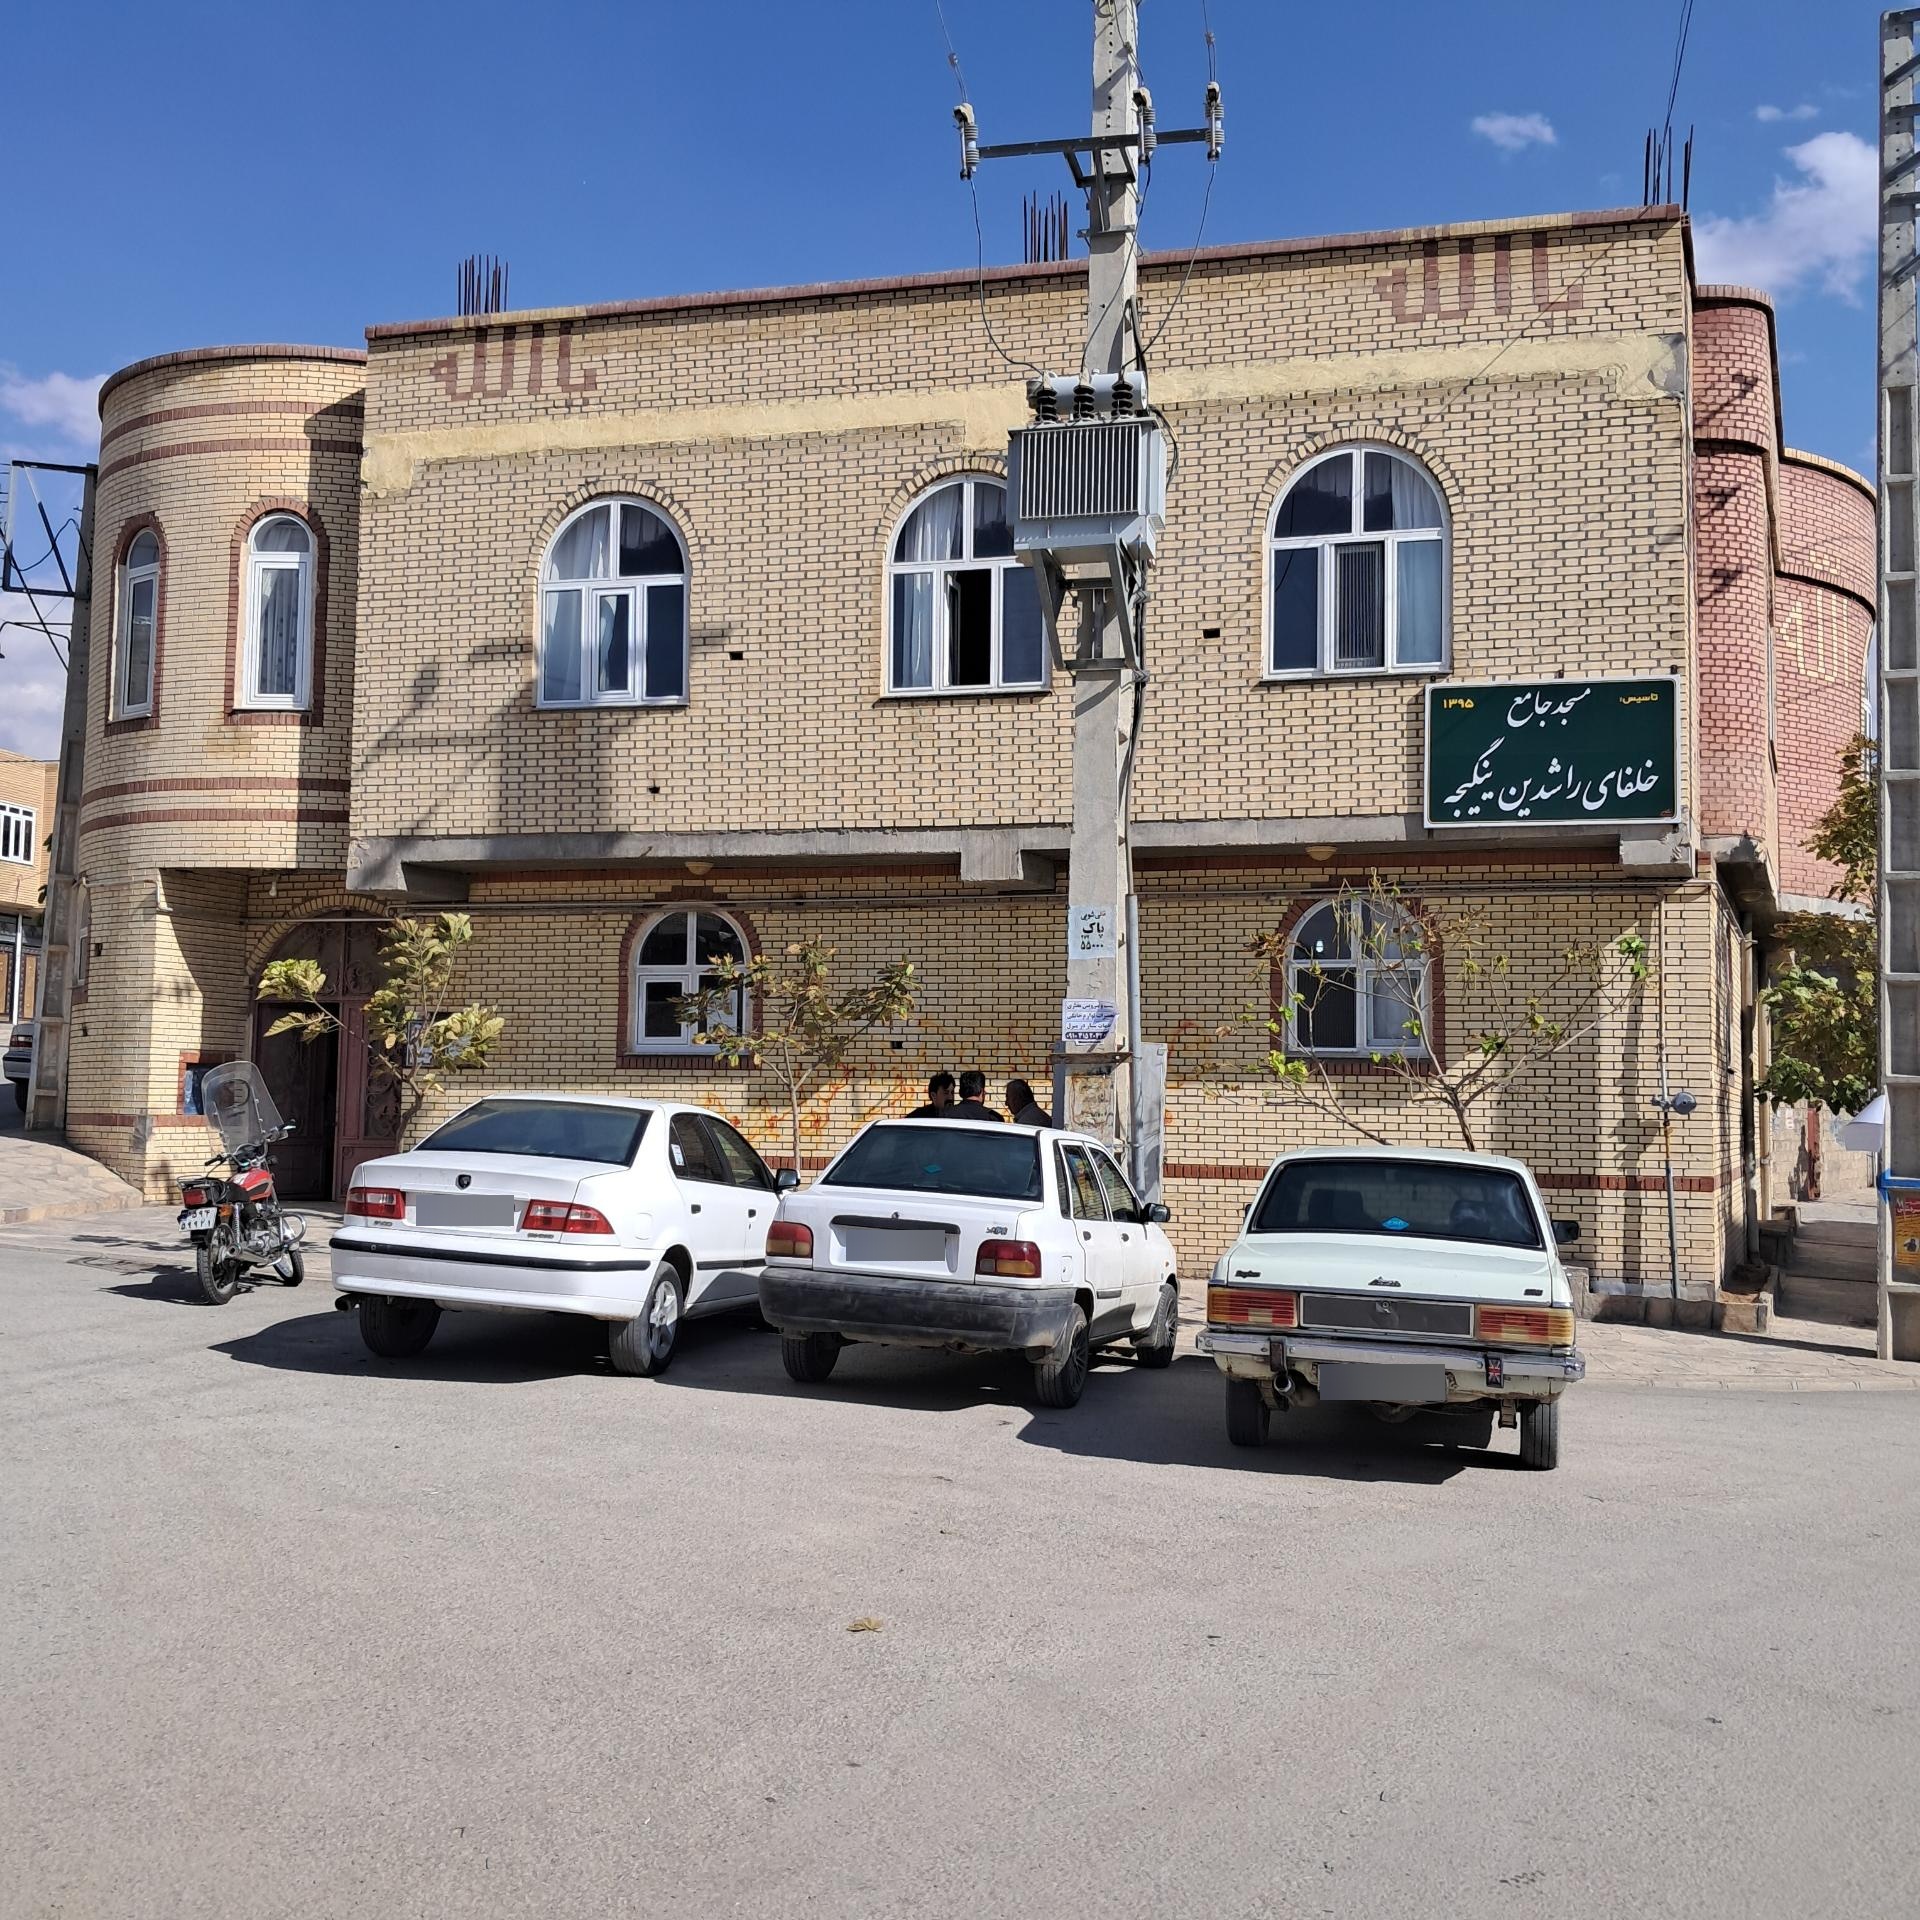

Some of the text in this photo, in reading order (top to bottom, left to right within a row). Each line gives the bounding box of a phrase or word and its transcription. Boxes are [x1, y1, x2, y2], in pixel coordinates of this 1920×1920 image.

[1443, 698, 1475, 709] ۱۳۹۵
[1506, 687, 1592, 728] مسجد جامع
[1498, 757, 1582, 817] راشدین
[1582, 759, 1660, 811] خلفای
[1082, 921, 1105, 938] پاک
